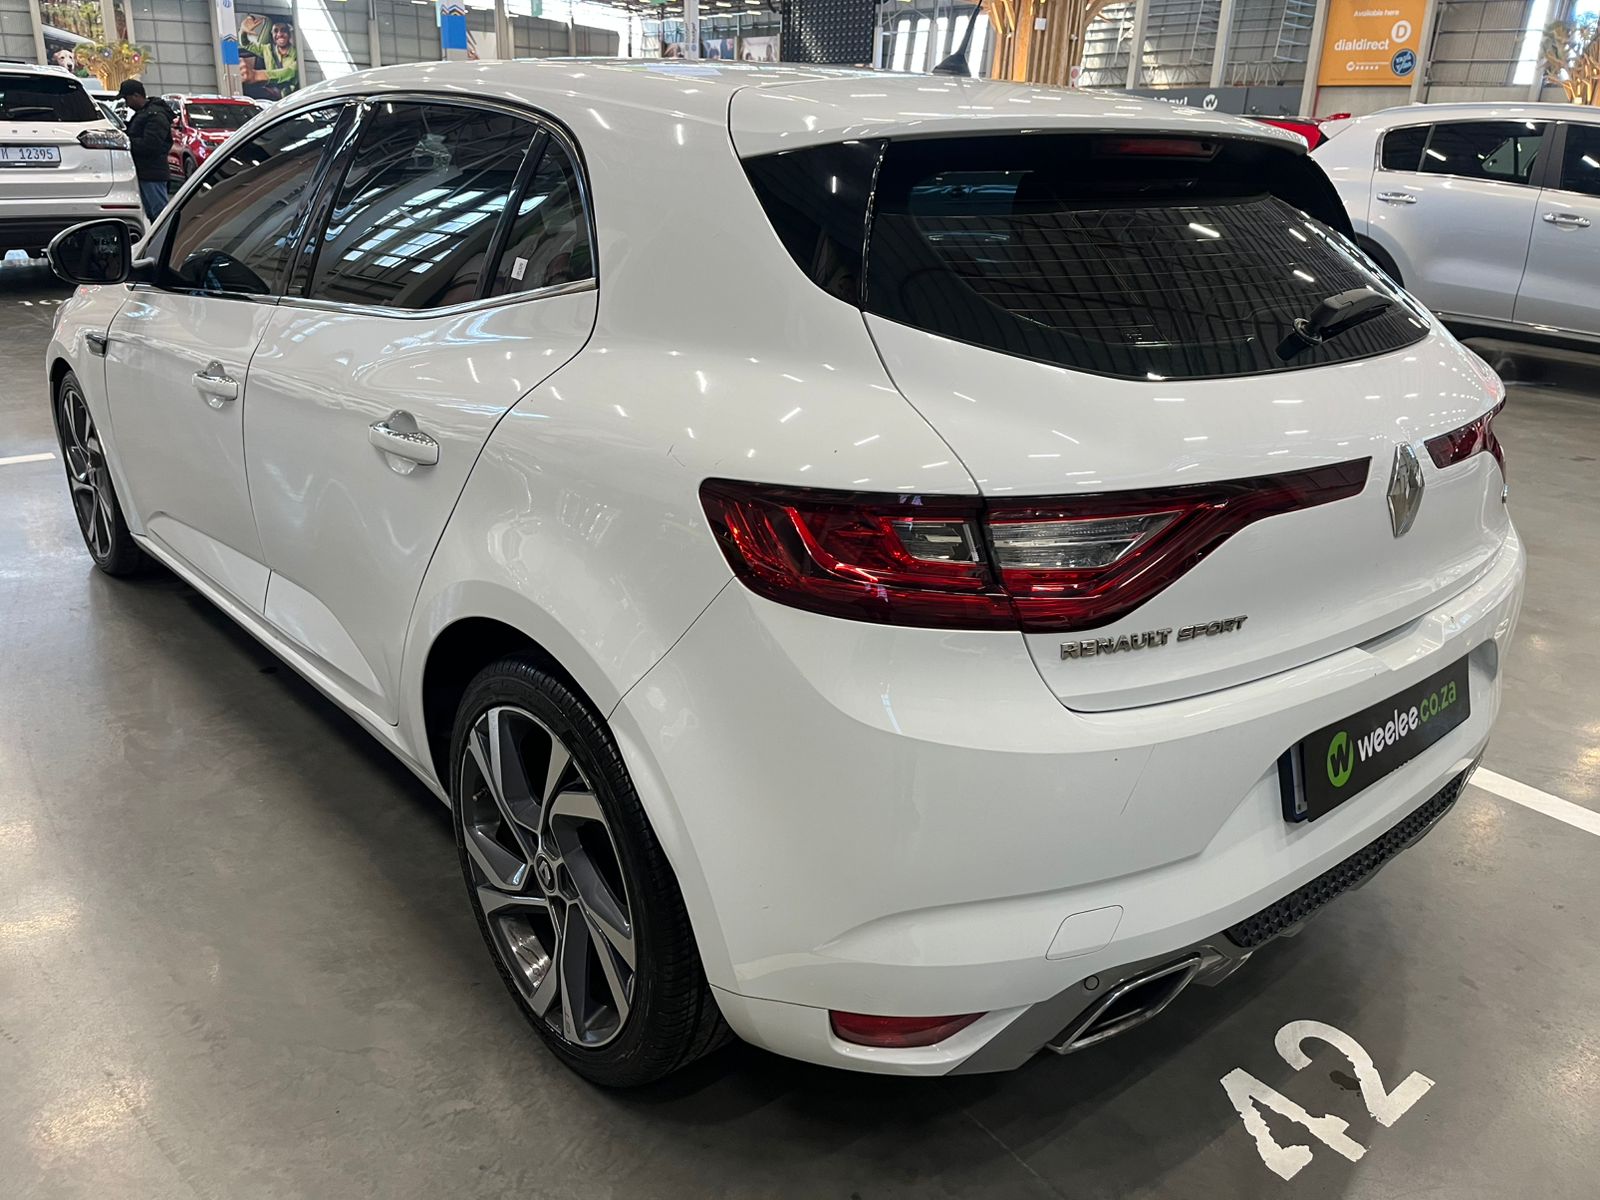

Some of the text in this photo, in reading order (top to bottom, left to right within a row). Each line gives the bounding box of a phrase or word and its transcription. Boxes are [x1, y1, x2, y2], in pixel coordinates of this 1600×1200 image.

[1353, 9, 1383, 17] Available
[1334, 38, 1390, 51] dialdirect
[19, 148, 54, 160] 12395
[1059, 614, 1248, 661] RENAULT SPORT
[1357, 680, 1457, 762] weelee.co.za
[1219, 1019, 1436, 1182] 42
